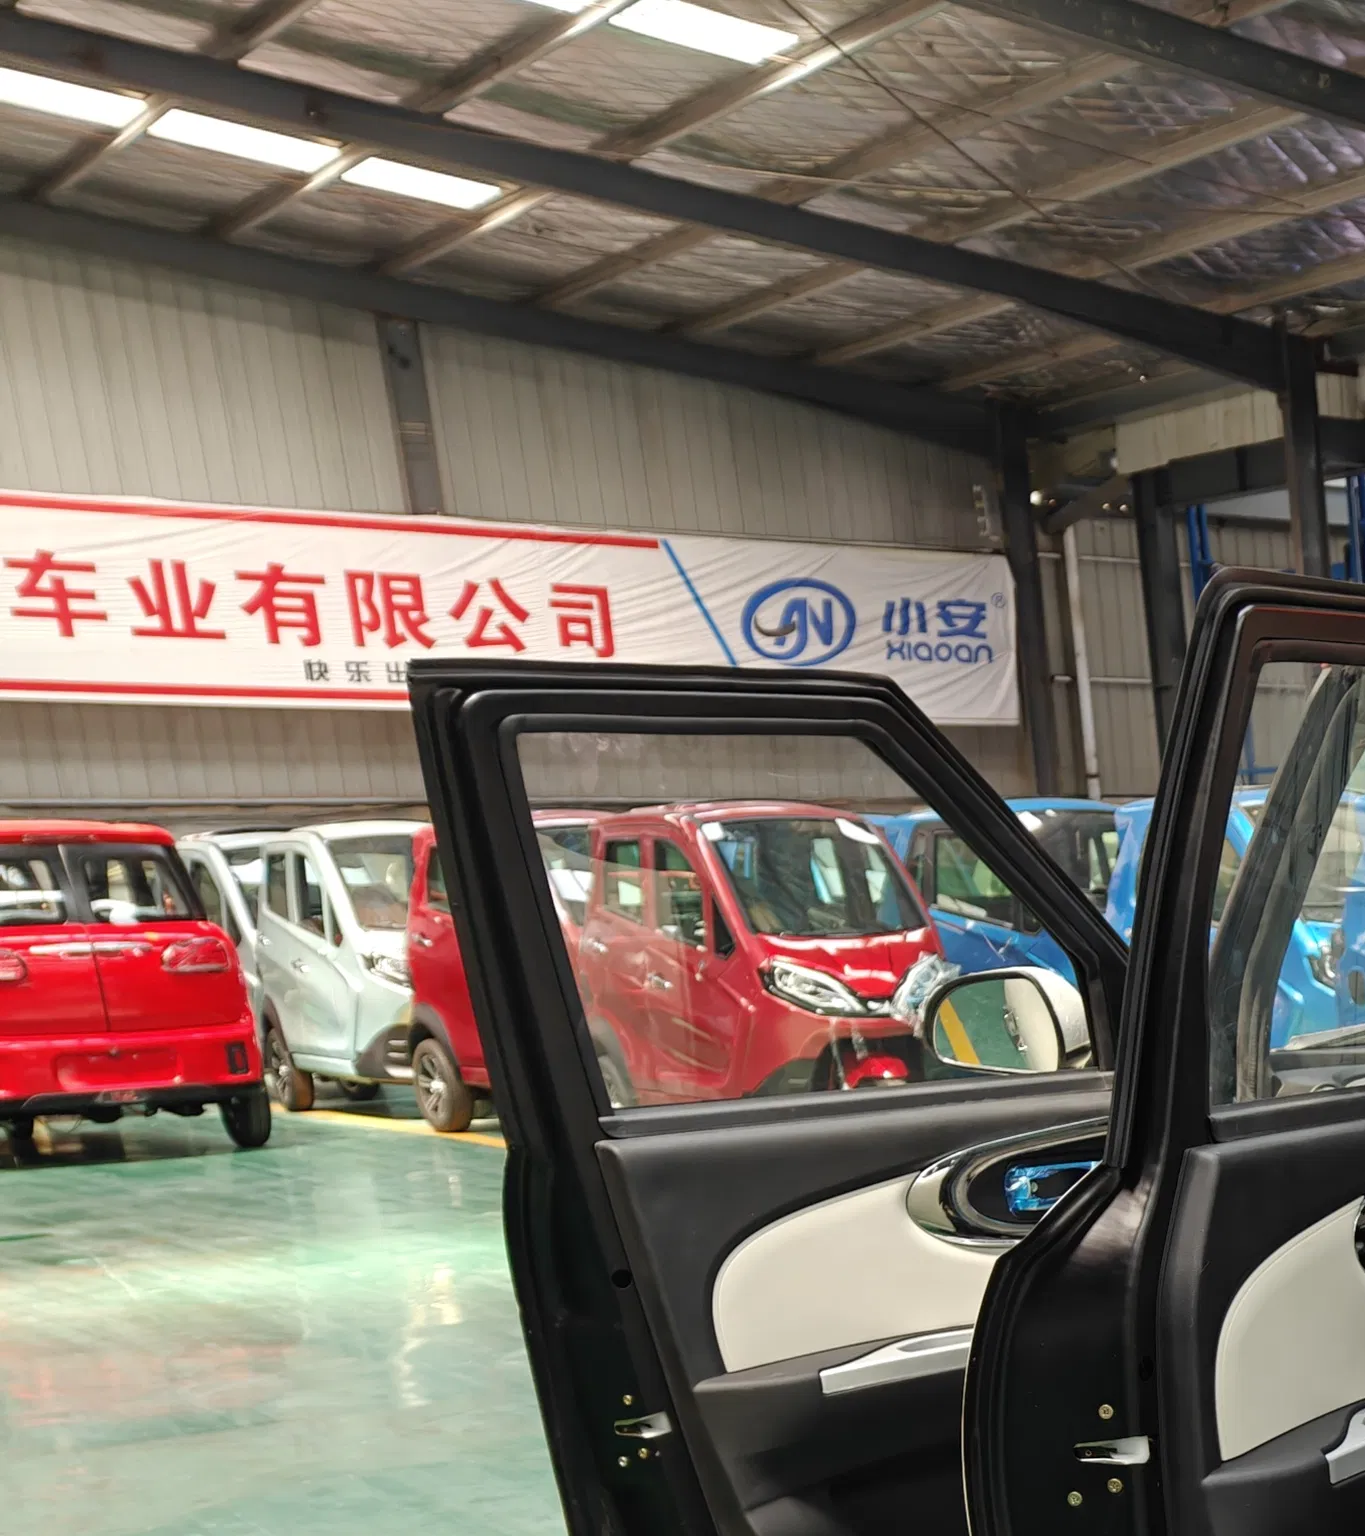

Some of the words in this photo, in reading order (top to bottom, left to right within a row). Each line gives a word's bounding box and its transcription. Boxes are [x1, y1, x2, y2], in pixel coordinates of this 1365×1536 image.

[3, 549, 615, 658] 车业有限公司
[882, 597, 987, 639] 小安
